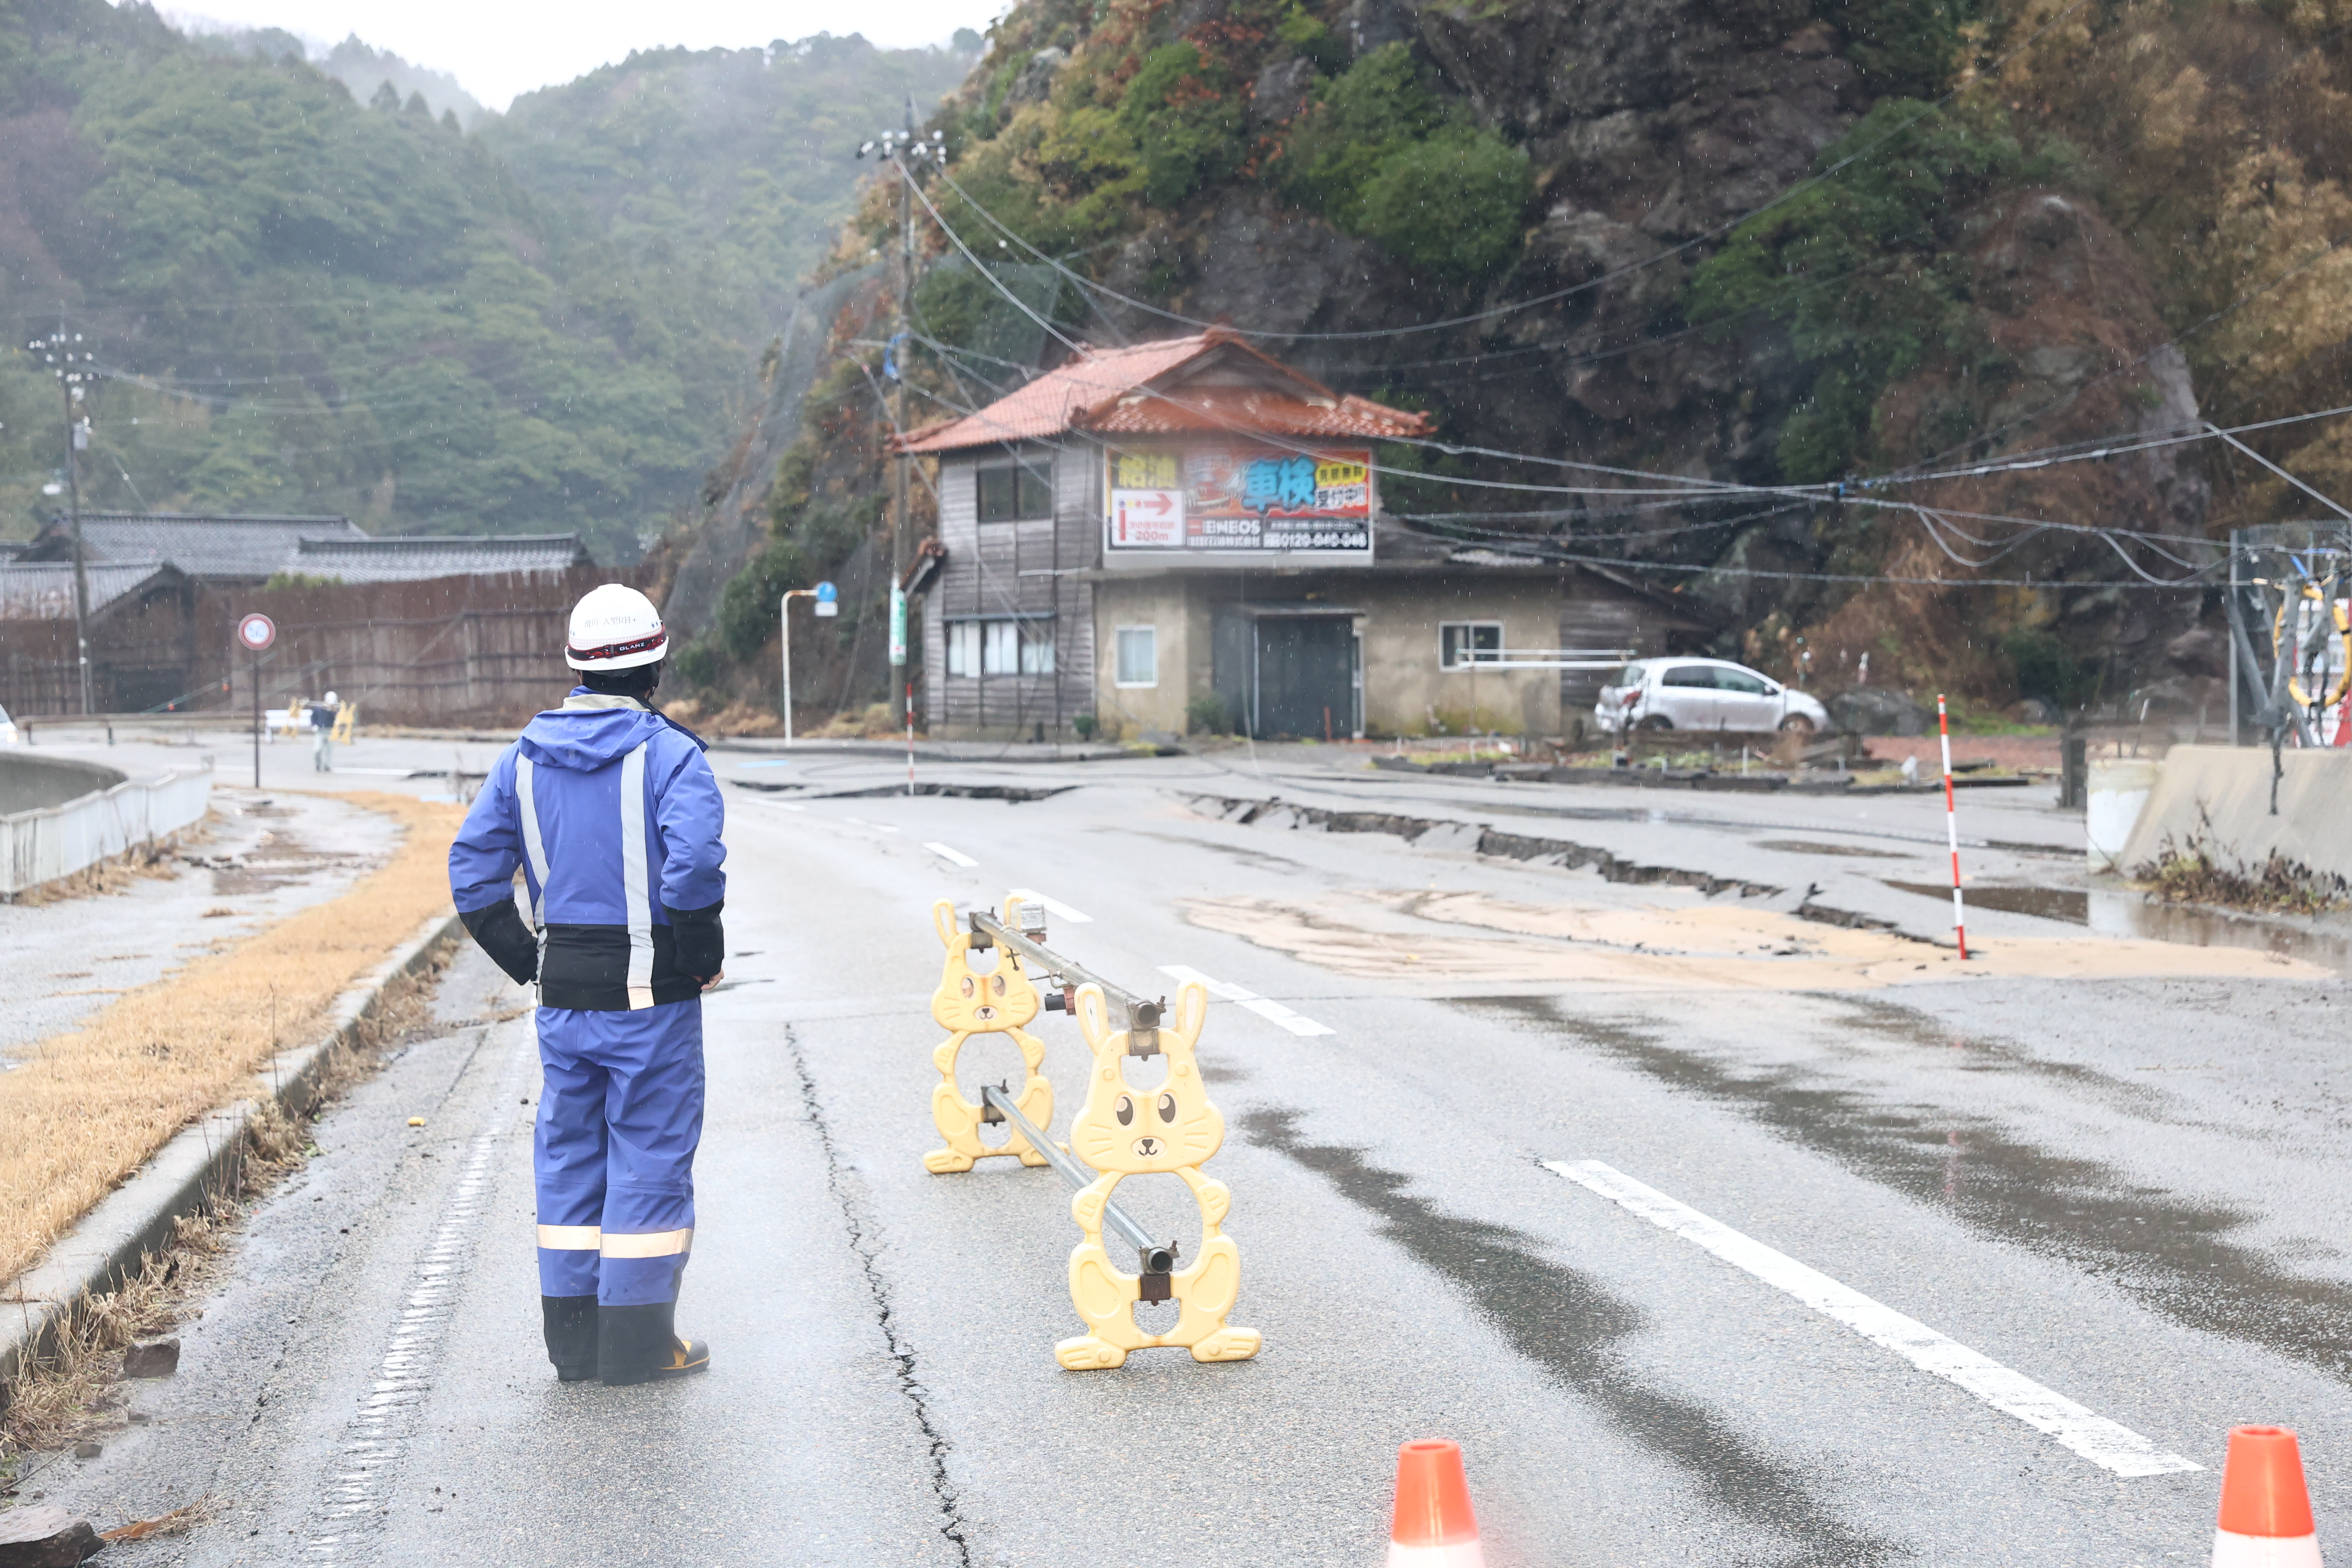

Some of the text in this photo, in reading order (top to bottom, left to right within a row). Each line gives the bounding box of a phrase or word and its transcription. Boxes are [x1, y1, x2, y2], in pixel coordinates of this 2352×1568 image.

[1243, 456, 1315, 512] 車検
[1205, 519, 1261, 535] ENEOS
[1135, 530, 1169, 541] 200m
[619, 642, 644, 651] GLANZ
